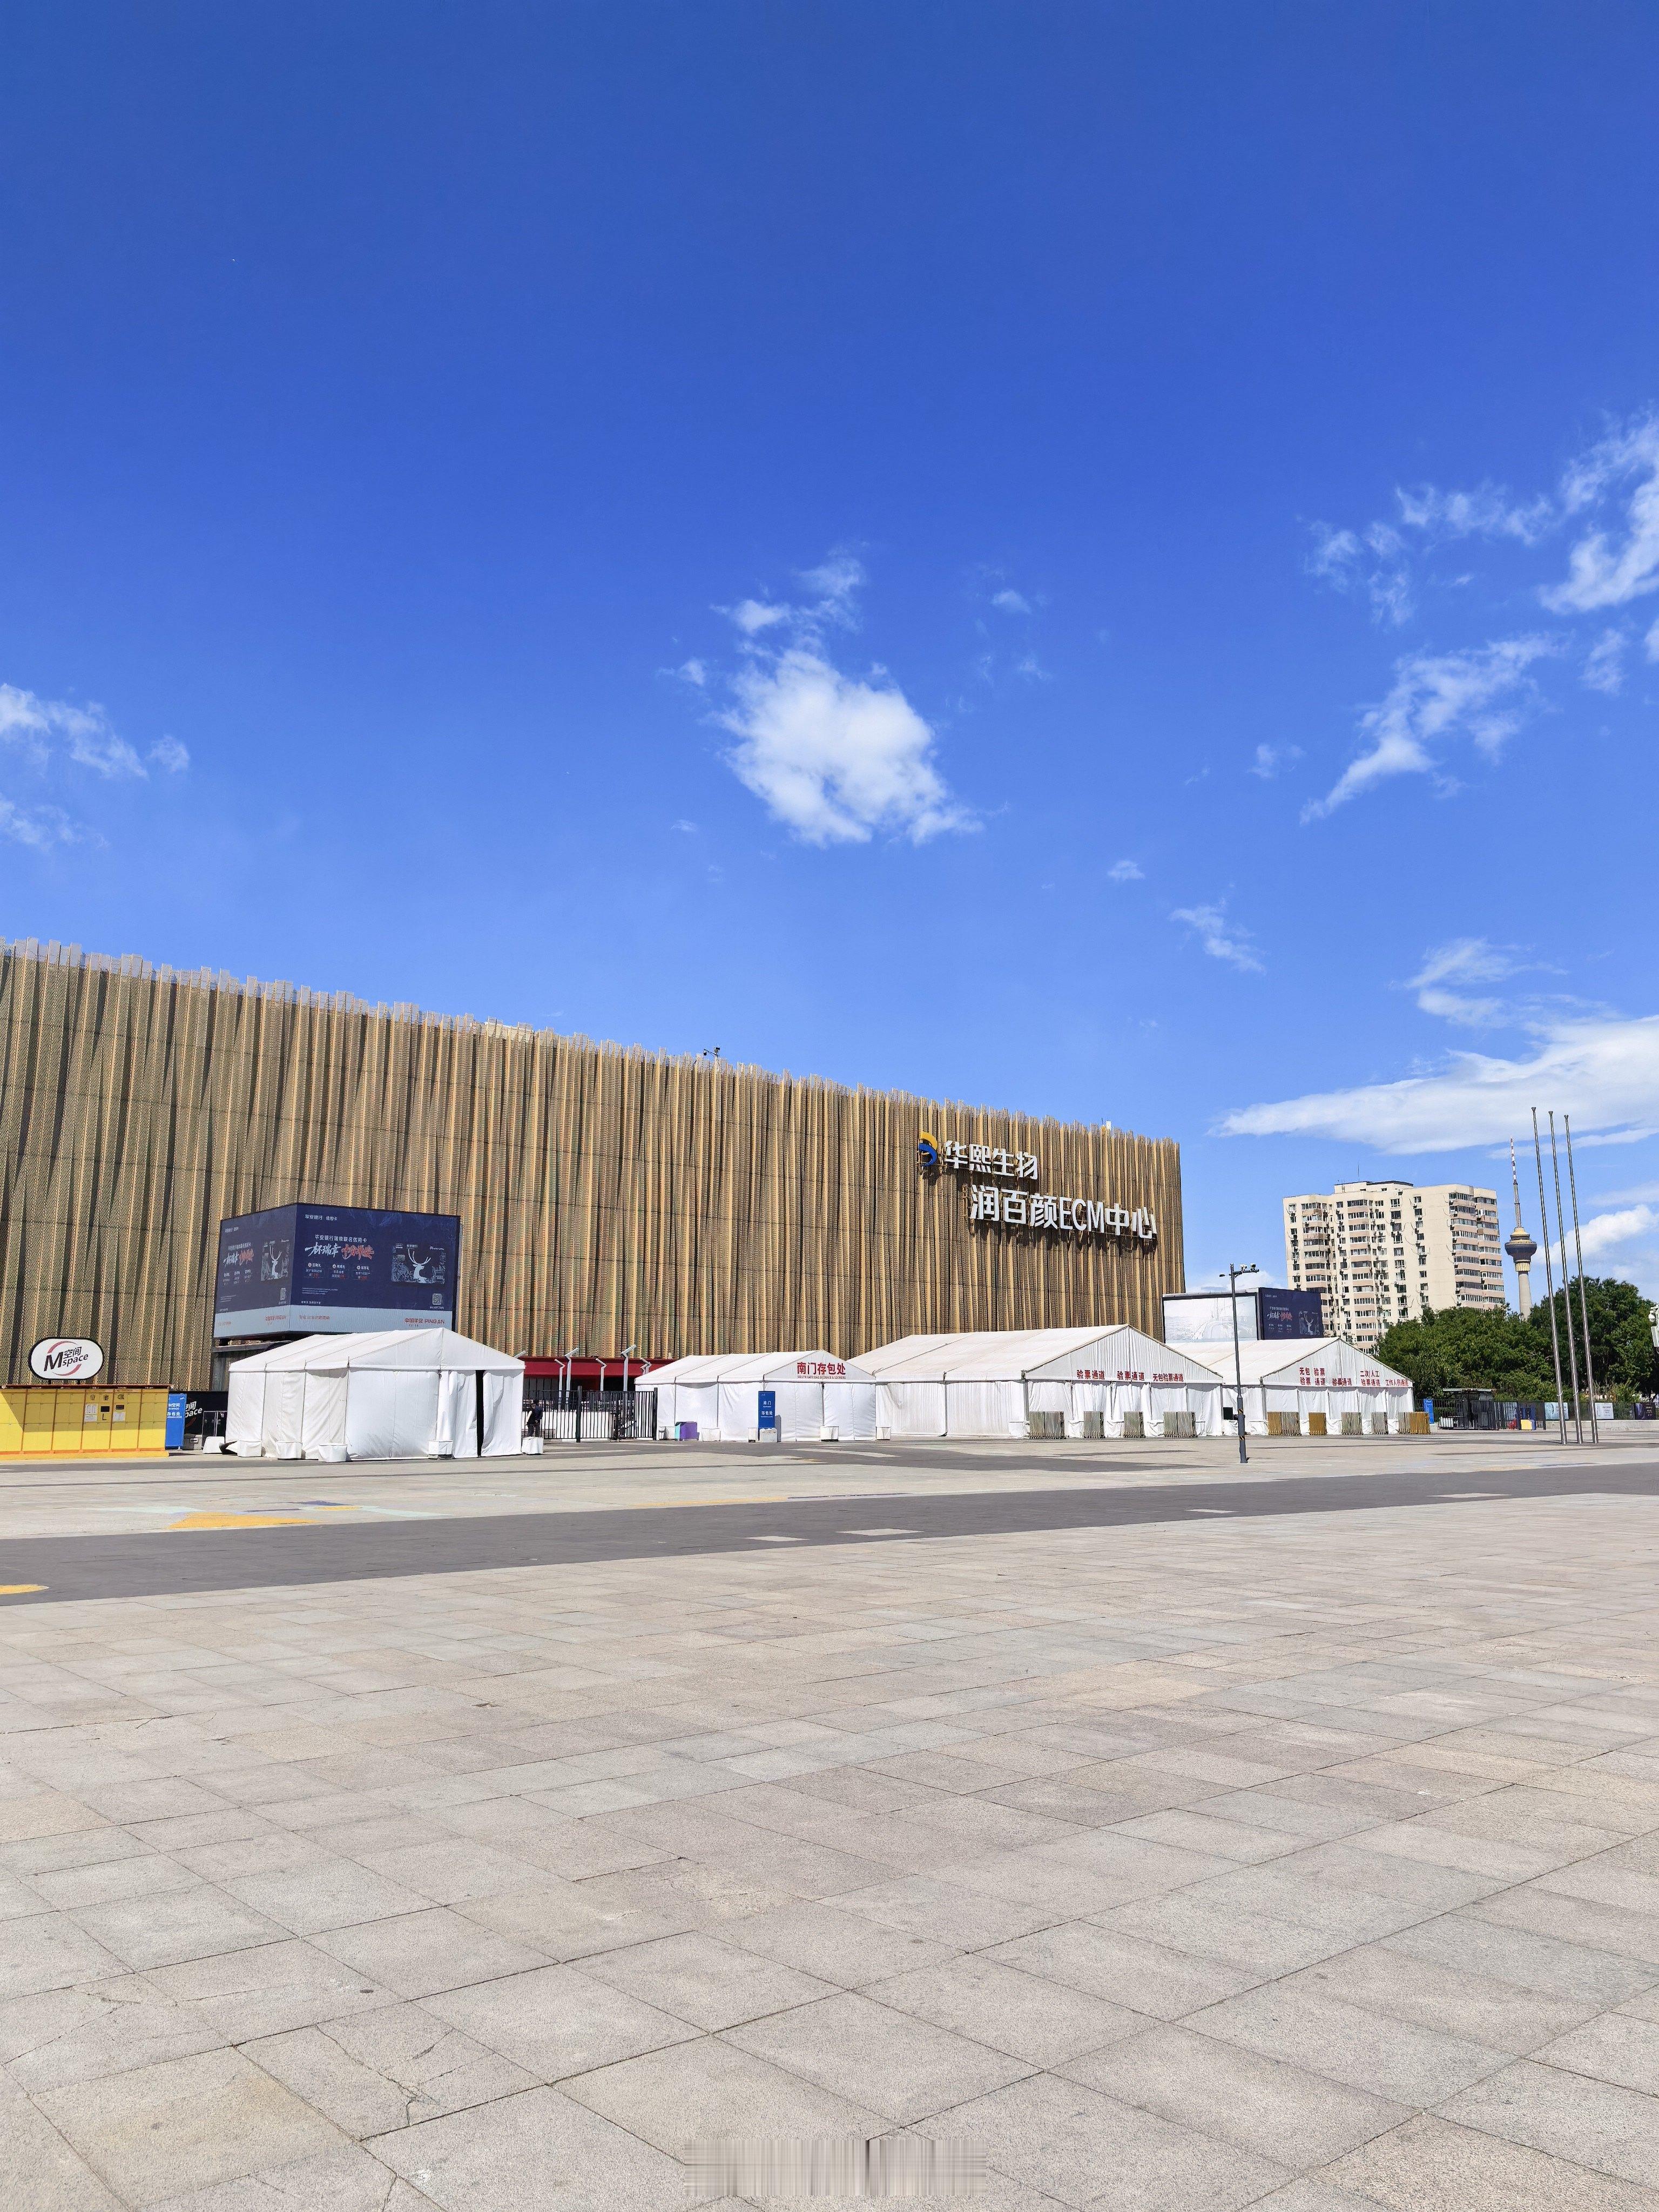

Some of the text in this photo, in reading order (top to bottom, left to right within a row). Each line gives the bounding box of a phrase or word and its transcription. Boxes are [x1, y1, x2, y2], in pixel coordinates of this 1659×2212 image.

[946, 1139, 1038, 1179] 华熙生物
[970, 1184, 1157, 1239] 润百颜ECM中心
[797, 1361, 846, 1375] 南门存包处
[1299, 1367, 1310, 1375] 无包
[1077, 1370, 1105, 1380] 验票通道
[1117, 1371, 1145, 1381] 验票通道
[1152, 1373, 1184, 1382] 无包验票通道
